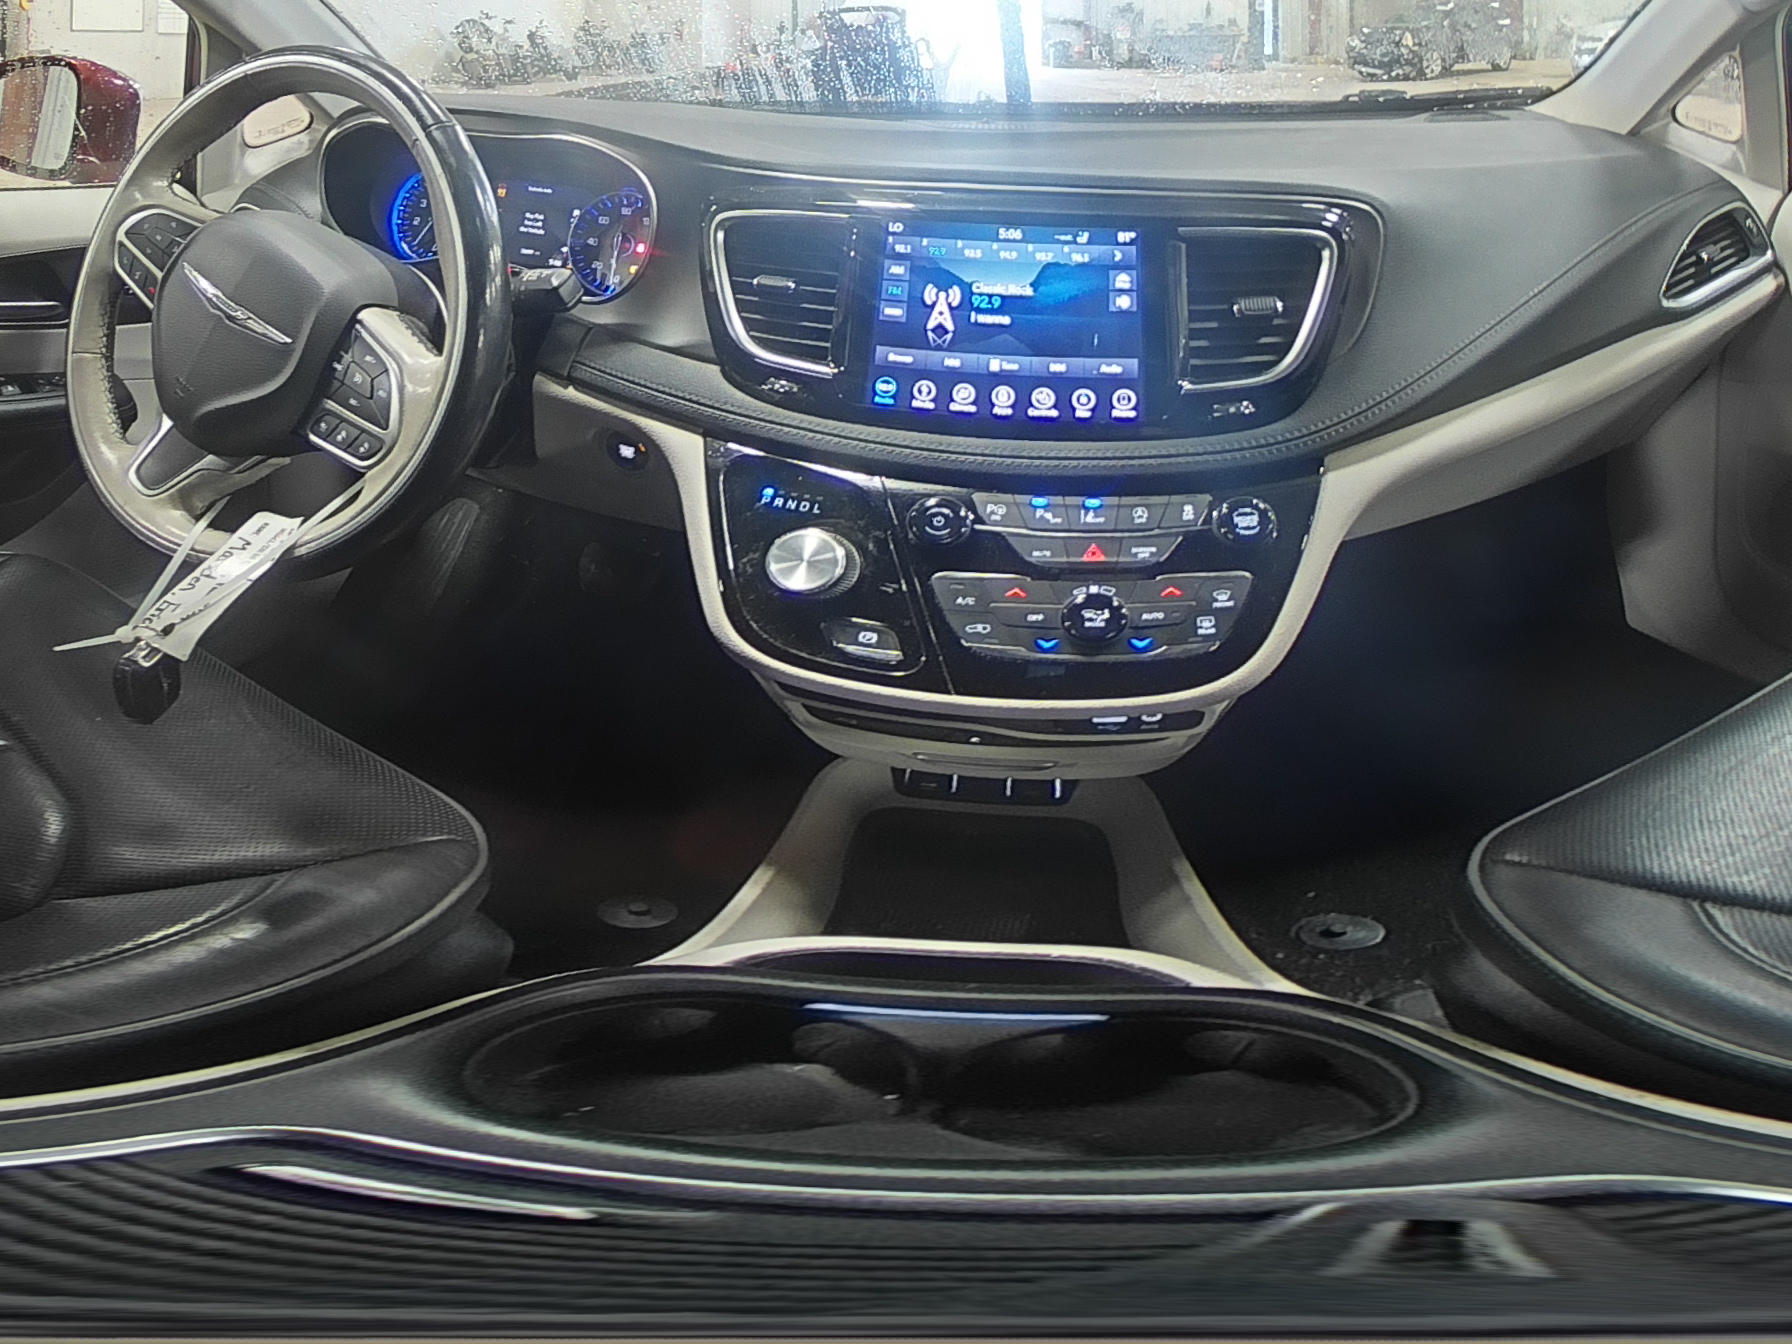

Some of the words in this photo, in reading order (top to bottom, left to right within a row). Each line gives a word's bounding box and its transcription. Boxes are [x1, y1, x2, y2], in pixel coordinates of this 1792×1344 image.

[412, 217, 421, 226] 2
[888, 222, 904, 233] LO
[998, 228, 1023, 240] 5:06
[1008, 285, 1035, 297] Rock
[971, 294, 1001, 308] 92.9
[955, 596, 976, 606] A/C
[1141, 611, 1165, 621] AUTO
